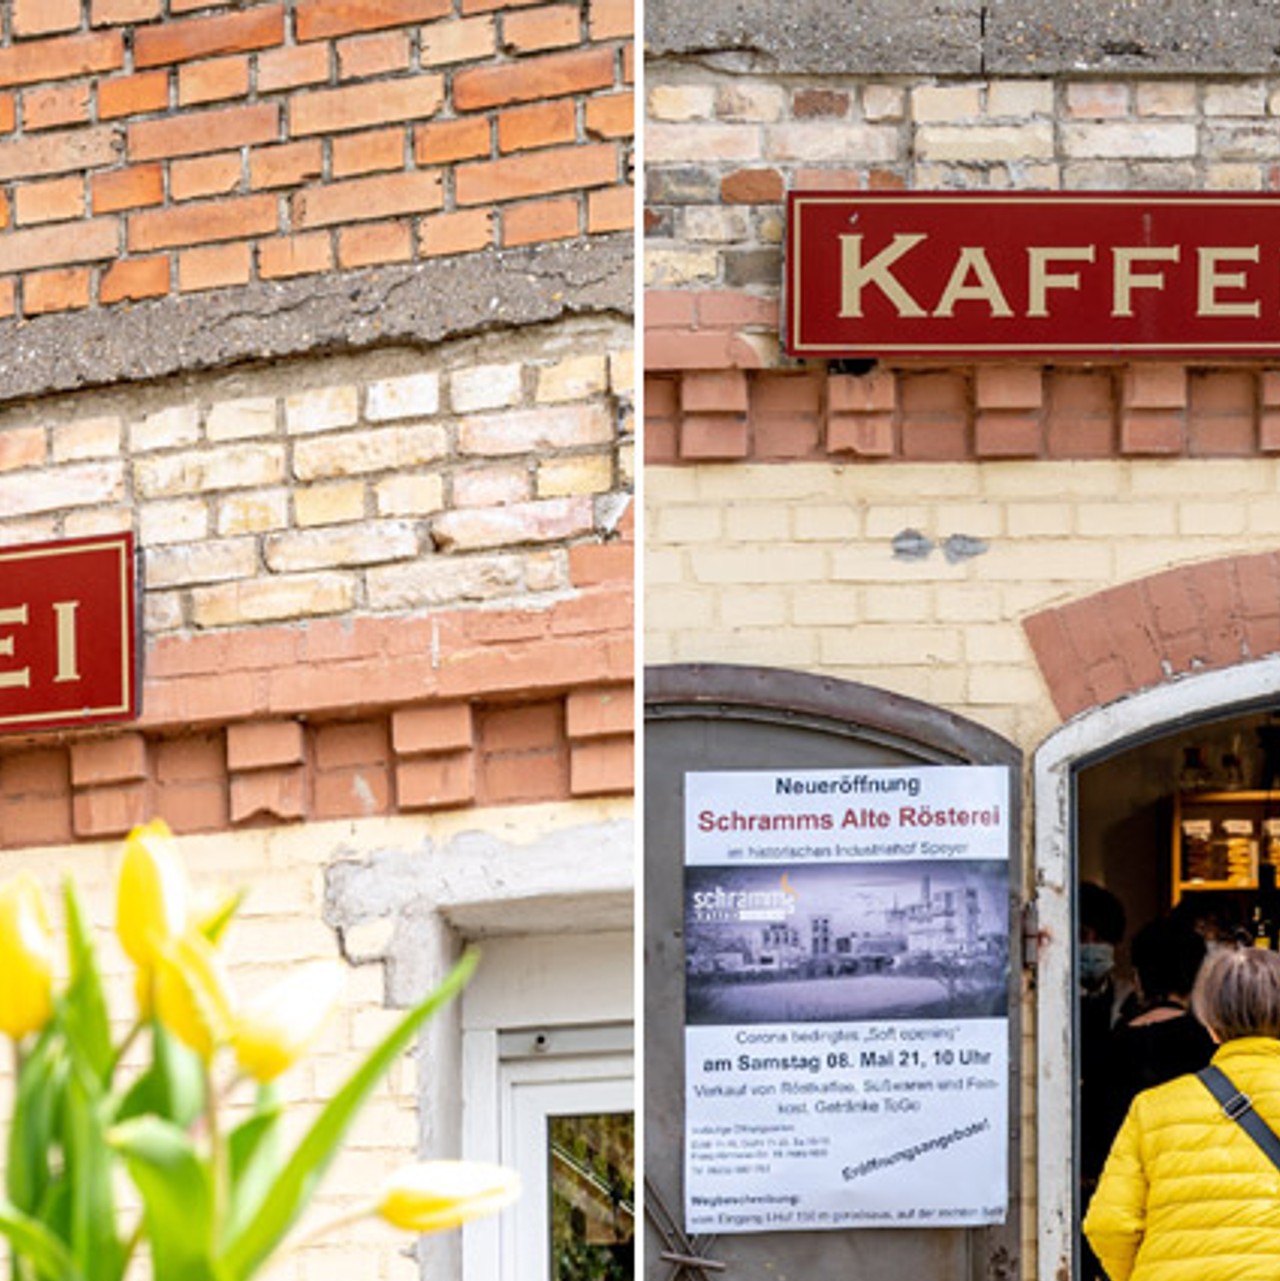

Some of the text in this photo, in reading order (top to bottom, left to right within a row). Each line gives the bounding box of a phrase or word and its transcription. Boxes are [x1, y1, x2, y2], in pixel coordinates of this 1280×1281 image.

[775, 775, 920, 796] Neueröffnung
[698, 804, 1001, 832] Schramms Alte Rösterei
[703, 1048, 992, 1074] am Samstag 08. Mai 21, 10 Uhr
